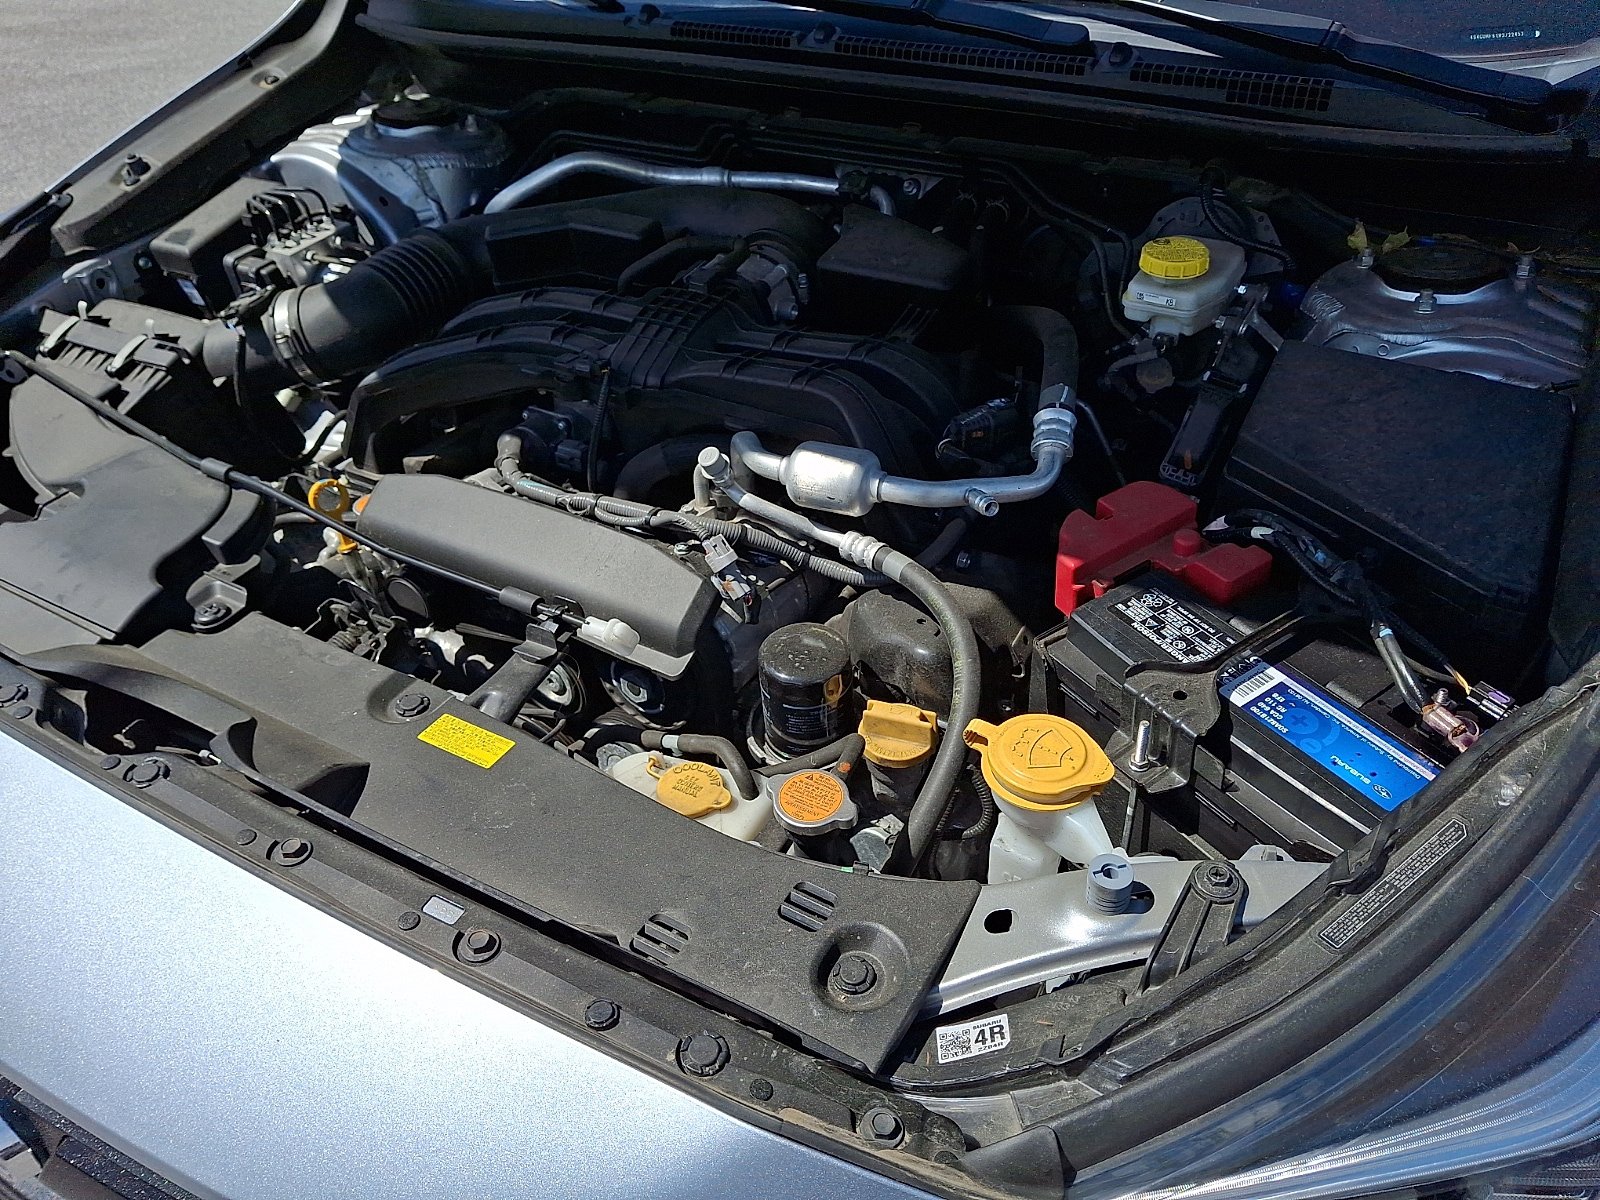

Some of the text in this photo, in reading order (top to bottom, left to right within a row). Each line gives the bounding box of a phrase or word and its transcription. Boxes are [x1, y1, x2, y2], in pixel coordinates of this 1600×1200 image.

[1131, 622, 1190, 663] ANGER/POISON
[1256, 701, 1284, 720] CCA 640
[1263, 696, 1287, 712] RC 110
[1365, 740, 1385, 754] Subaru
[673, 763, 720, 787] COOLANT
[1329, 754, 1372, 784] SUBARU
[1391, 759, 1421, 779] Distributed
[672, 785, 700, 798] MANUAL
[972, 1019, 1002, 1030] SUBARU
[974, 1024, 1007, 1046] 4R
